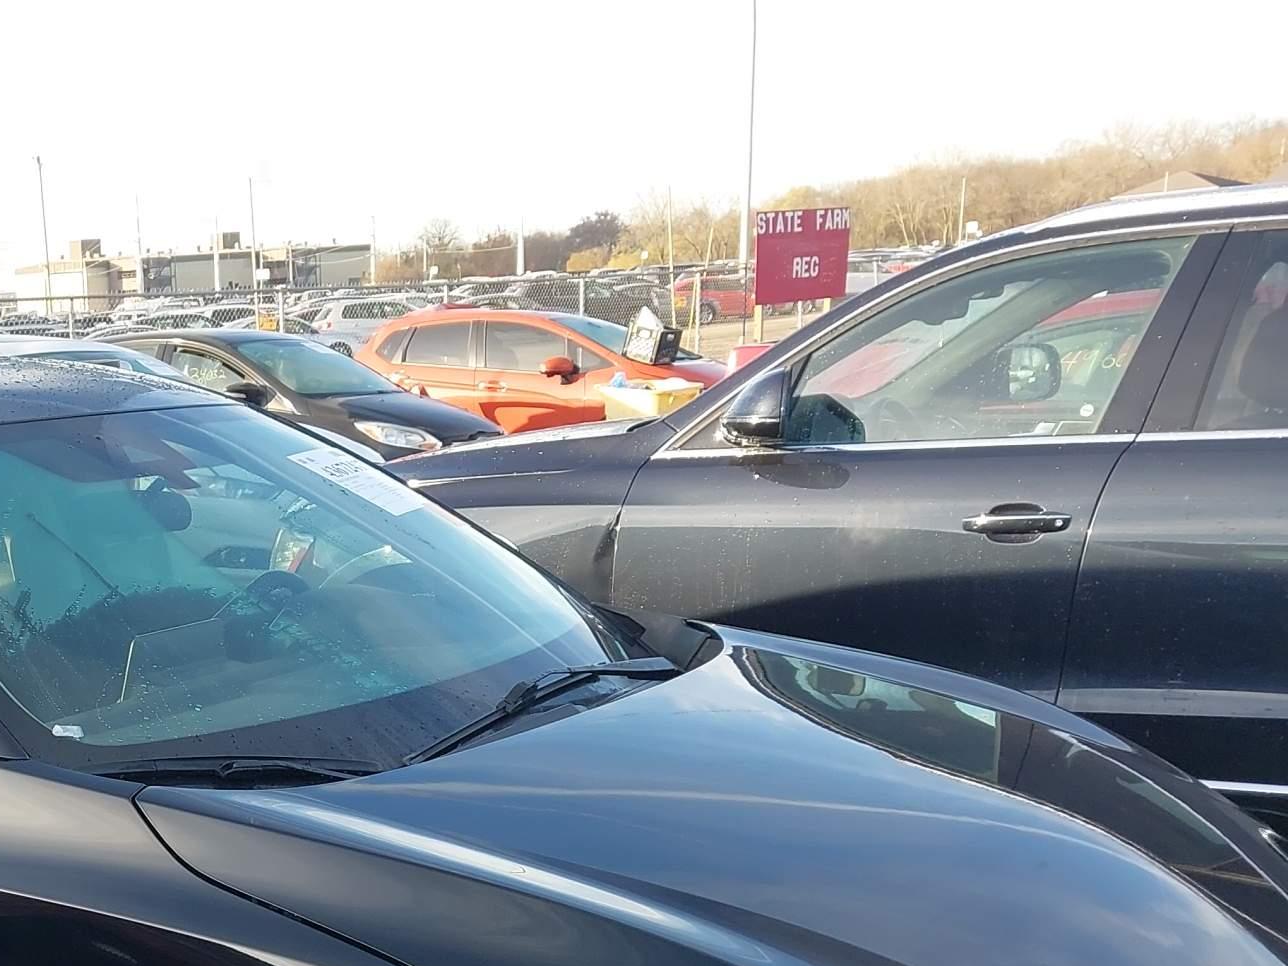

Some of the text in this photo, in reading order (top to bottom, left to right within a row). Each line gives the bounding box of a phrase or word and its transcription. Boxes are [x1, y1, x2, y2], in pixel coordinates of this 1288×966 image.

[757, 208, 850, 234] STATE FARM
[792, 256, 819, 278] REG
